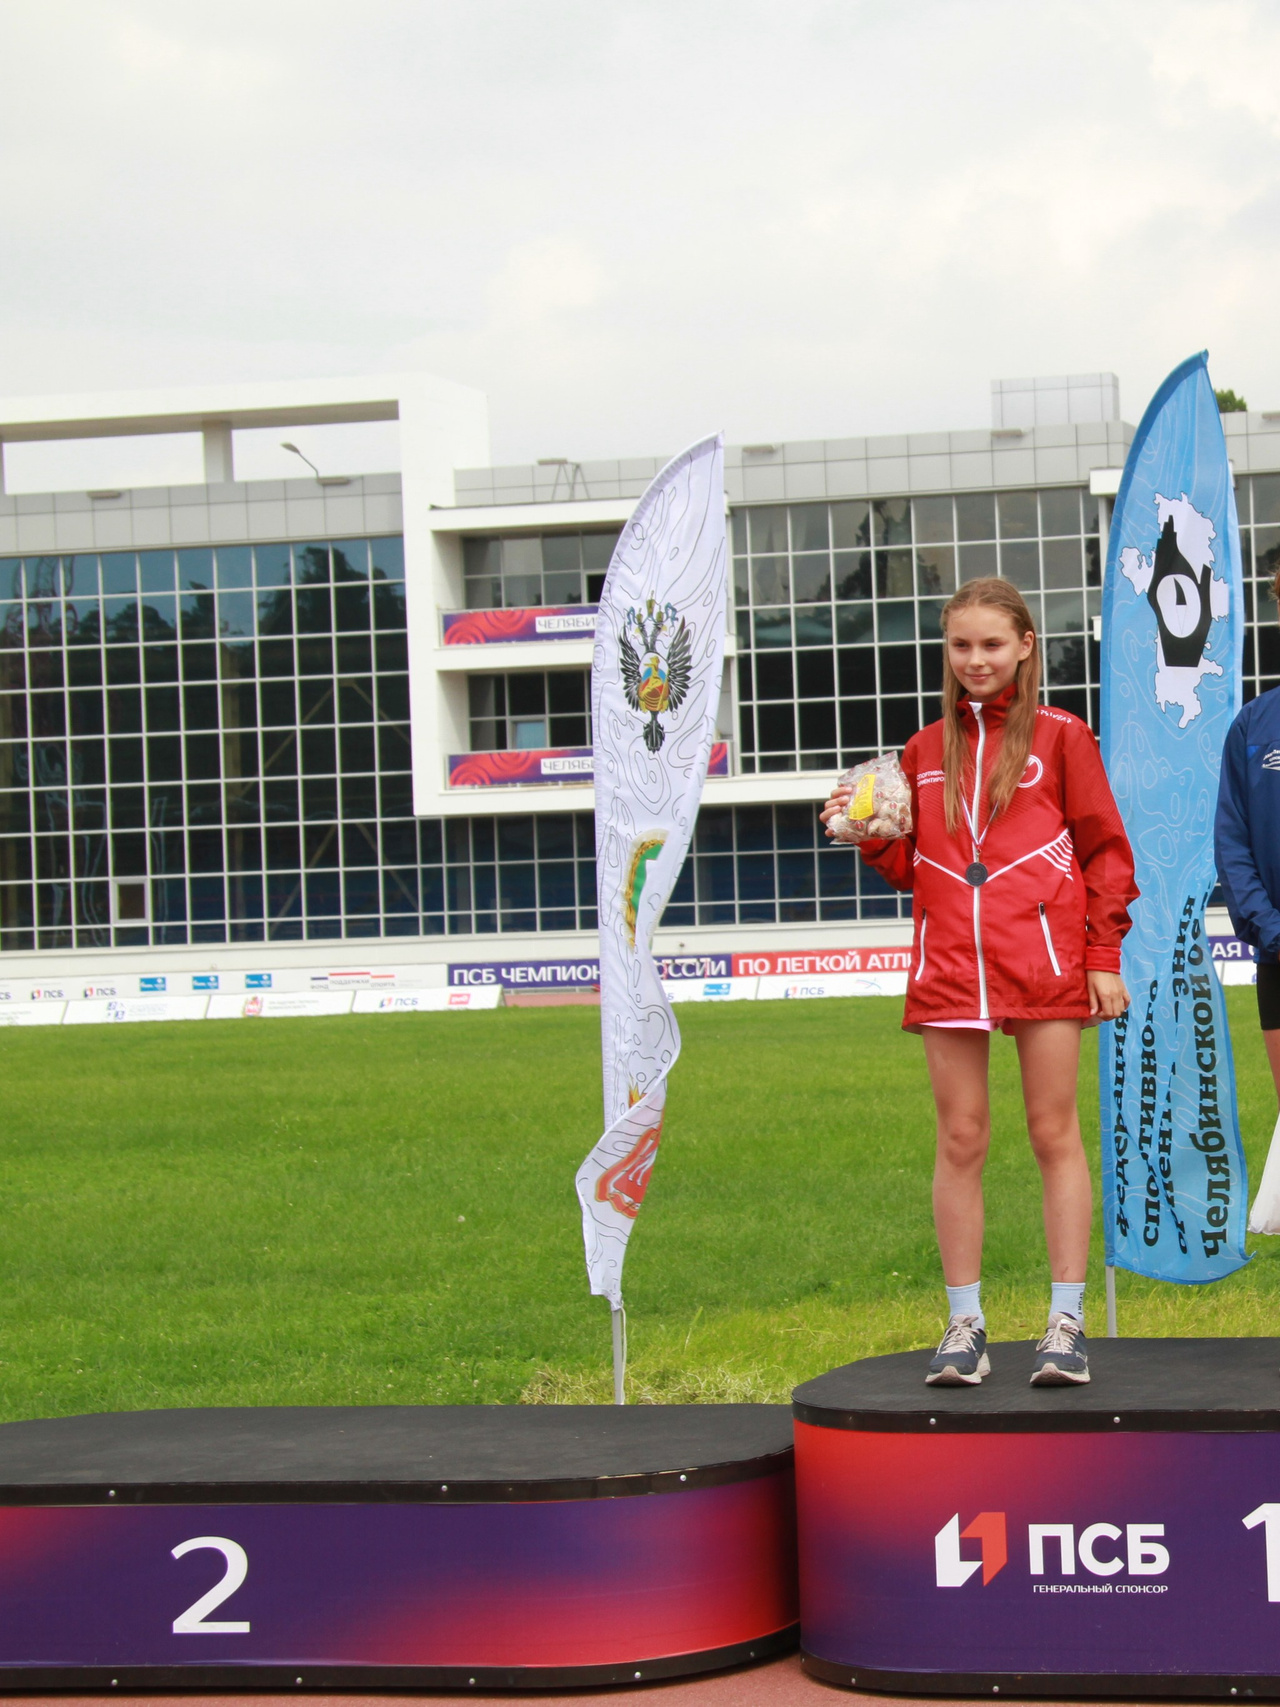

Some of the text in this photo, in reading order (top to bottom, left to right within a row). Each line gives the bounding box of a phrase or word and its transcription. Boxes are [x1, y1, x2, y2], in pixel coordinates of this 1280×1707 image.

[453, 968, 496, 985] ПСБ
[738, 957, 770, 975] ПО
[776, 951, 861, 973] ЛЕГКОЙ
[44, 988, 64, 998] ПСБ
[96, 986, 116, 996] ПСБ
[800, 986, 825, 995] ПСБ
[395, 997, 419, 1006] ПСБ
[1028, 1522, 1170, 1576] ПСБ
[171, 1536, 250, 1633] 2
[1033, 1583, 1168, 1593] ГЕНЕРАЛЬНЫЙ СПОНСОР
